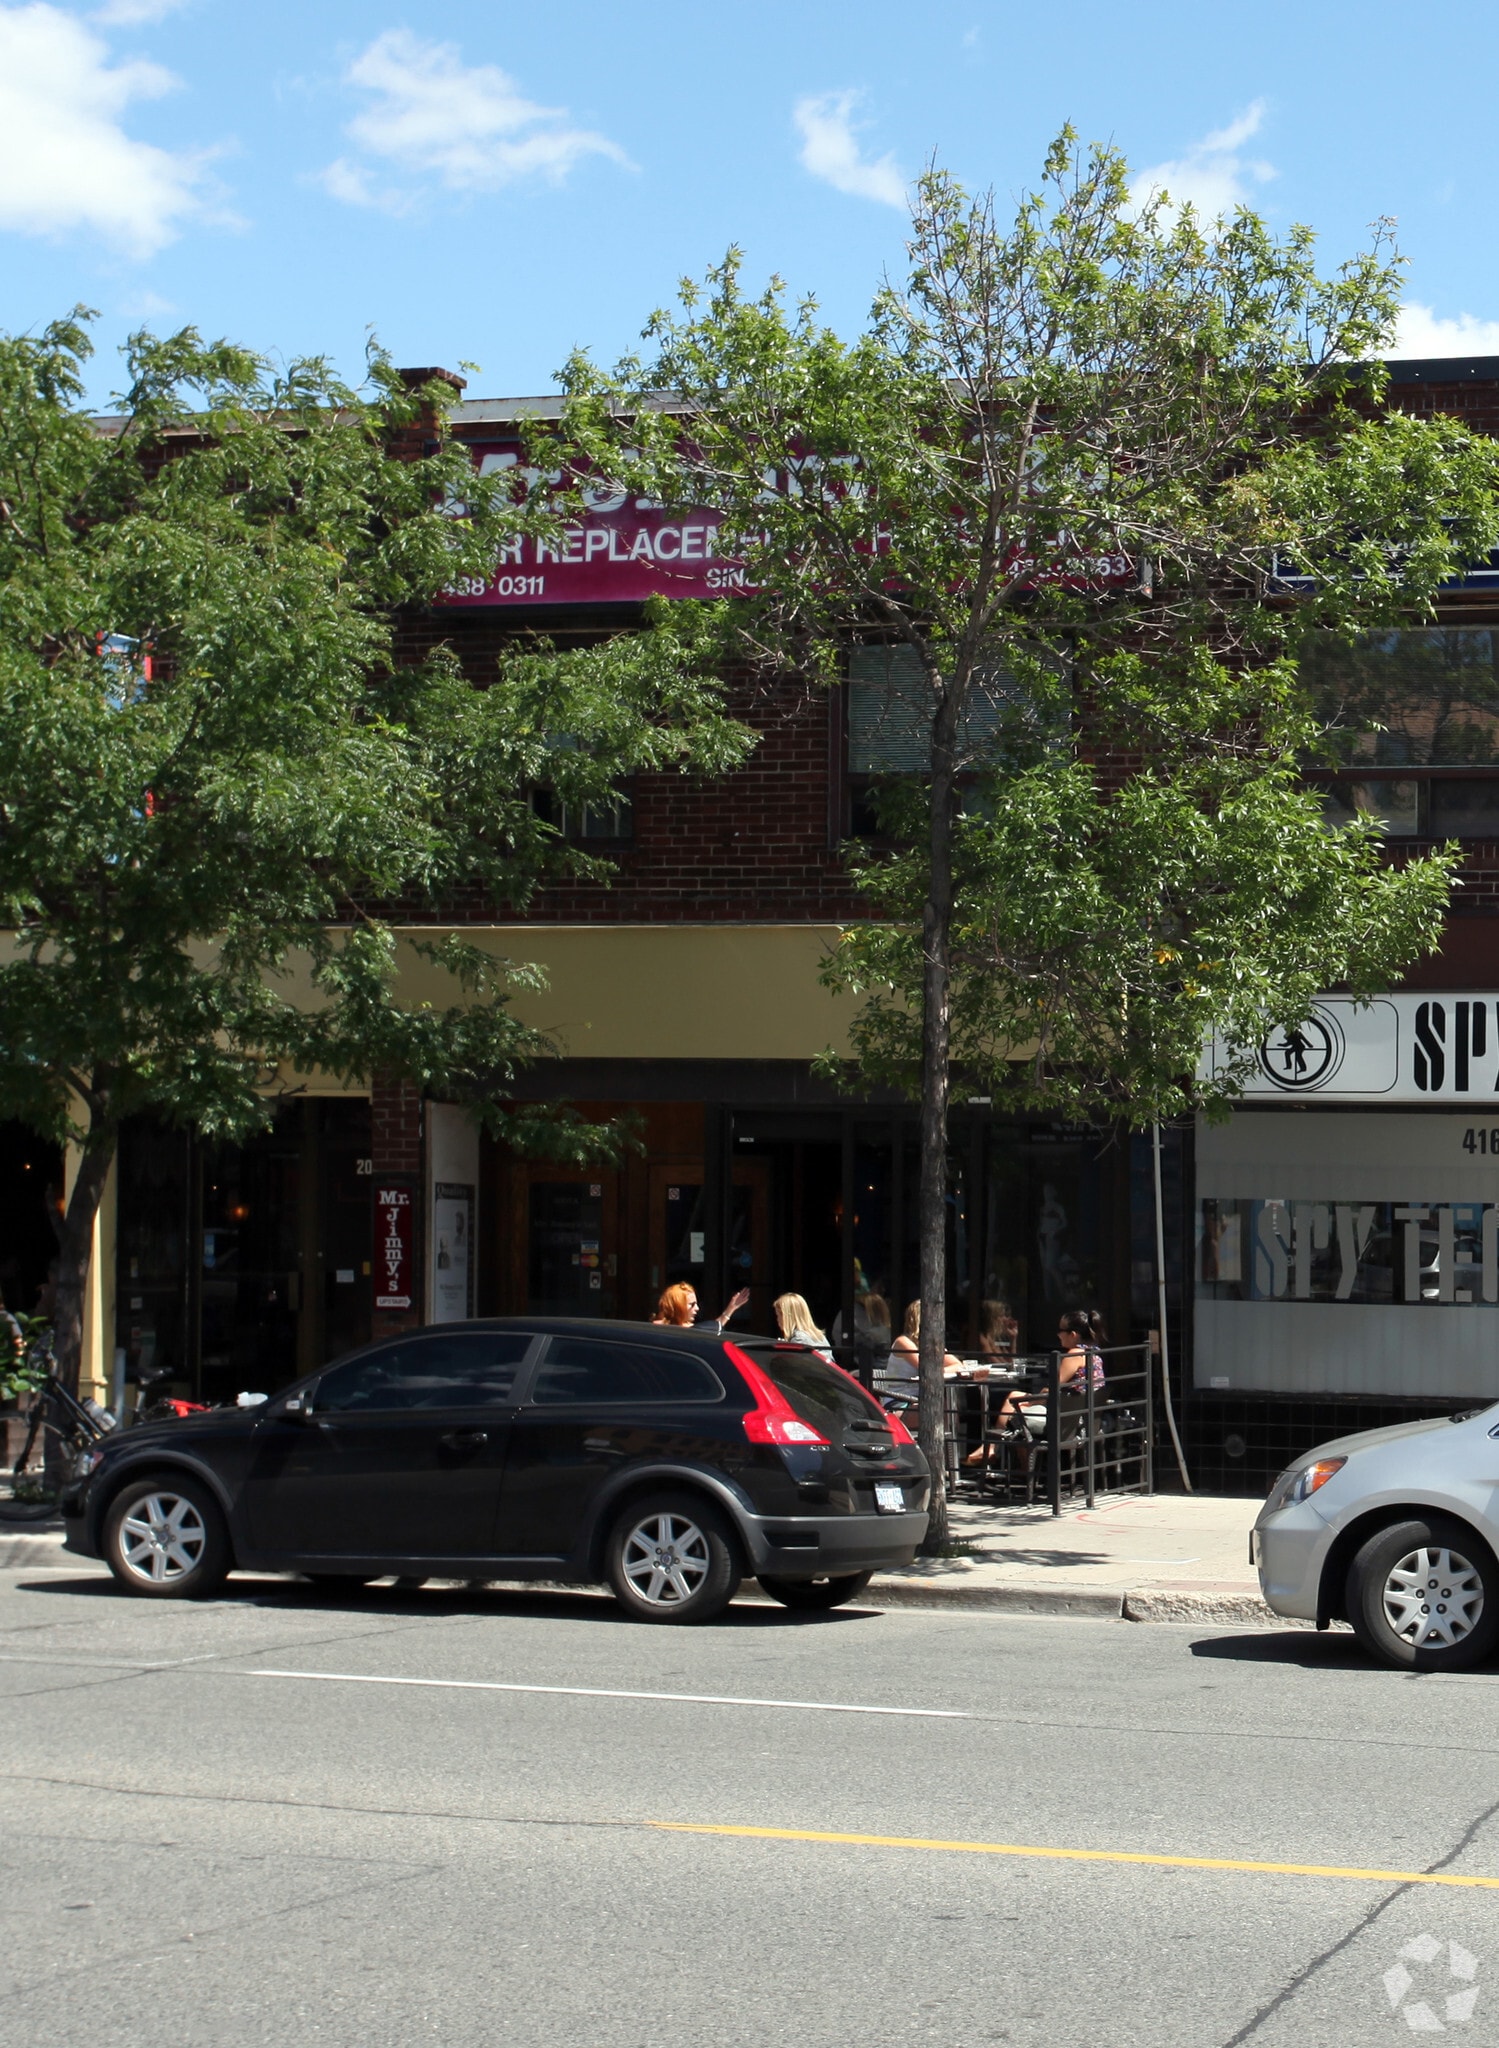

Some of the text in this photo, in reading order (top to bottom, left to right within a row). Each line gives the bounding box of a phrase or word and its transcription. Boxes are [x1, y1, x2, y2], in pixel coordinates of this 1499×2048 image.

[536, 525, 792, 564] REPLACEME
[498, 575, 545, 596] 0311
[706, 567, 772, 589] SINC
[1413, 1001, 1499, 1092] SP
[1462, 1128, 1499, 1155] 416
[356, 1159, 373, 1175] 20
[379, 1190, 410, 1205] Mr.
[385, 1207, 403, 1292] Jimmy's
[1255, 1203, 1377, 1300] SPY
